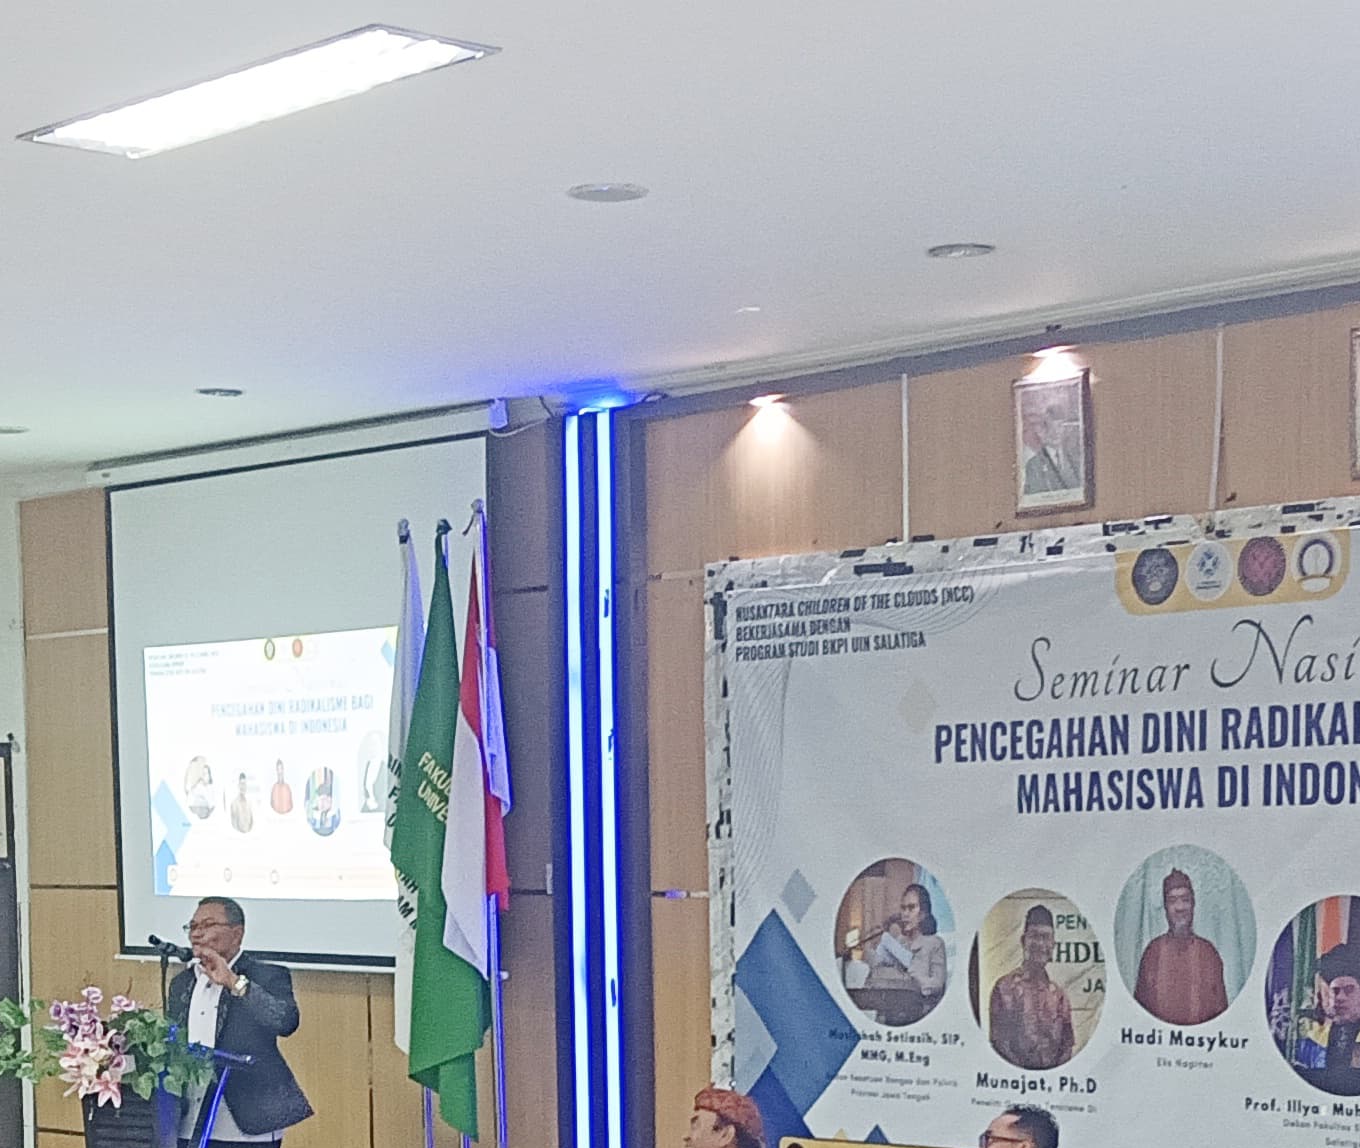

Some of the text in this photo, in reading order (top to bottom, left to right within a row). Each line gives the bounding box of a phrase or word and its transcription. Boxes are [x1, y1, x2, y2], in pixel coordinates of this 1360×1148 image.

[736, 601, 795, 622] NUSANTARA
[797, 598, 850, 616] CHILDREN
[853, 595, 867, 612] OF
[870, 593, 891, 610] THE
[894, 588, 938, 608] CLOUDS
[736, 617, 850, 642] BEKERJASAMA DENGAN
[736, 631, 927, 662] PROGRAM STUDI BKPI UIN SALATIGA
[1014, 637, 1190, 701] Seminar
[934, 714, 1129, 764] PENCEGAHAN
[1141, 709, 1208, 754] DINI
[1017, 766, 1204, 814] MAHASISWA
[1217, 765, 1249, 808] DI
[1047, 941, 1104, 963] HDL
[886, 1031, 937, 1046] Setiasih,
[941, 1033, 965, 1046] SIP,
[1121, 1027, 1248, 1052] Hadi Masykur
[895, 1051, 930, 1067] M.Eng
[976, 1072, 1097, 1094] Munajat, Ph.D
[1245, 1097, 1280, 1112] Prof.
[1287, 1100, 1320, 1117] Illya
